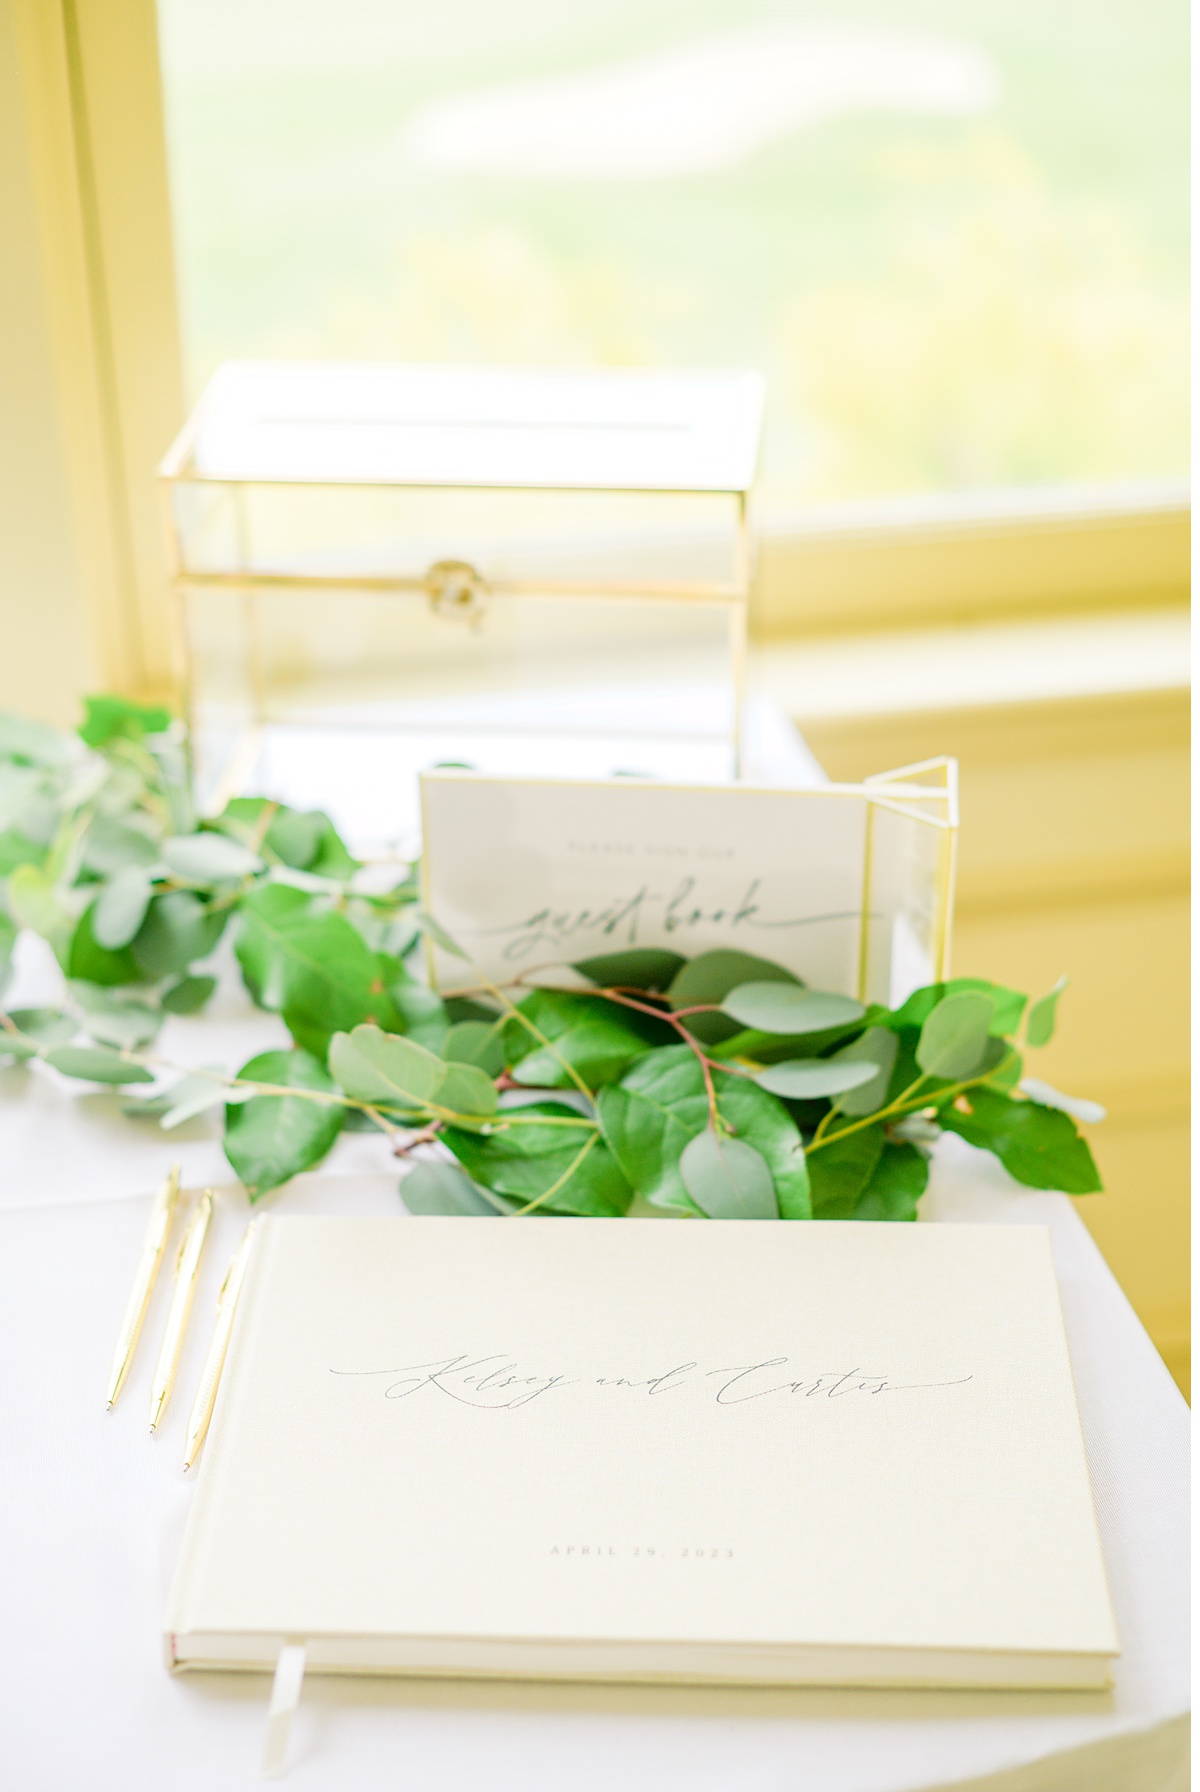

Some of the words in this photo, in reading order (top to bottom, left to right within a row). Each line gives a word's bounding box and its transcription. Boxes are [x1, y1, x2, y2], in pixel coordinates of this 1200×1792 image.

[567, 840, 635, 856] PLEASE
[646, 843, 688, 858] SIGN
[697, 846, 735, 860] OUR
[453, 884, 661, 960] guest
[664, 876, 882, 932] book
[329, 1354, 581, 1410] Kelsey
[595, 1362, 698, 1396] and
[706, 1356, 973, 1405] Curtis
[549, 1545, 617, 1556] APRIL
[681, 1547, 736, 1558] 2023
